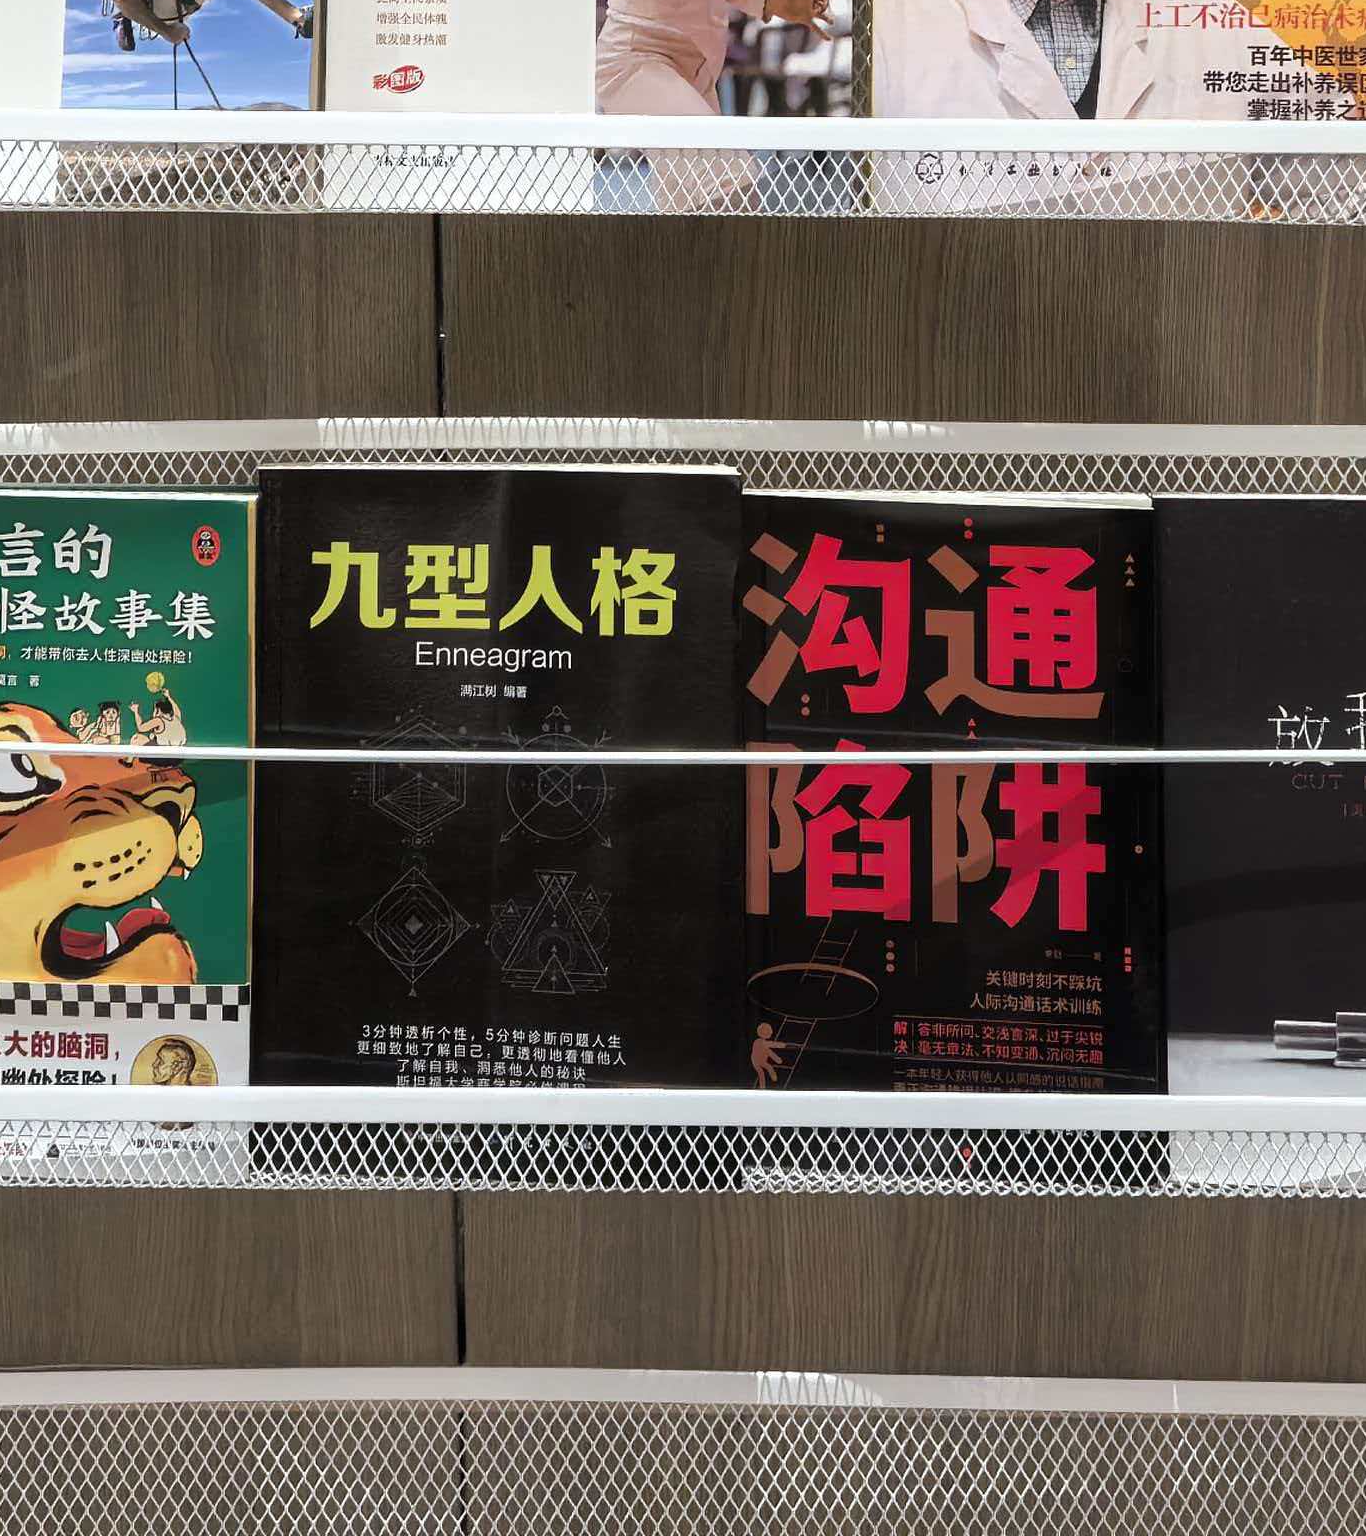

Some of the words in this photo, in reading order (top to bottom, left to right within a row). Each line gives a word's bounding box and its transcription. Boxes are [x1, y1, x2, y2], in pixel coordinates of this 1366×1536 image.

[310, 541, 677, 637] 九型人格
[742, 532, 1105, 720] 沟通
[415, 640, 573, 673] Enneagram
[1291, 774, 1345, 791] CUT
[745, 738, 1107, 932] 陷阱
[986, 970, 1103, 993] 关键时刻不踩坑
[970, 993, 1103, 1016] 人际沟通话术训练
[396, 1059, 587, 1081] 了解自我、洞悉他人的秘诀
